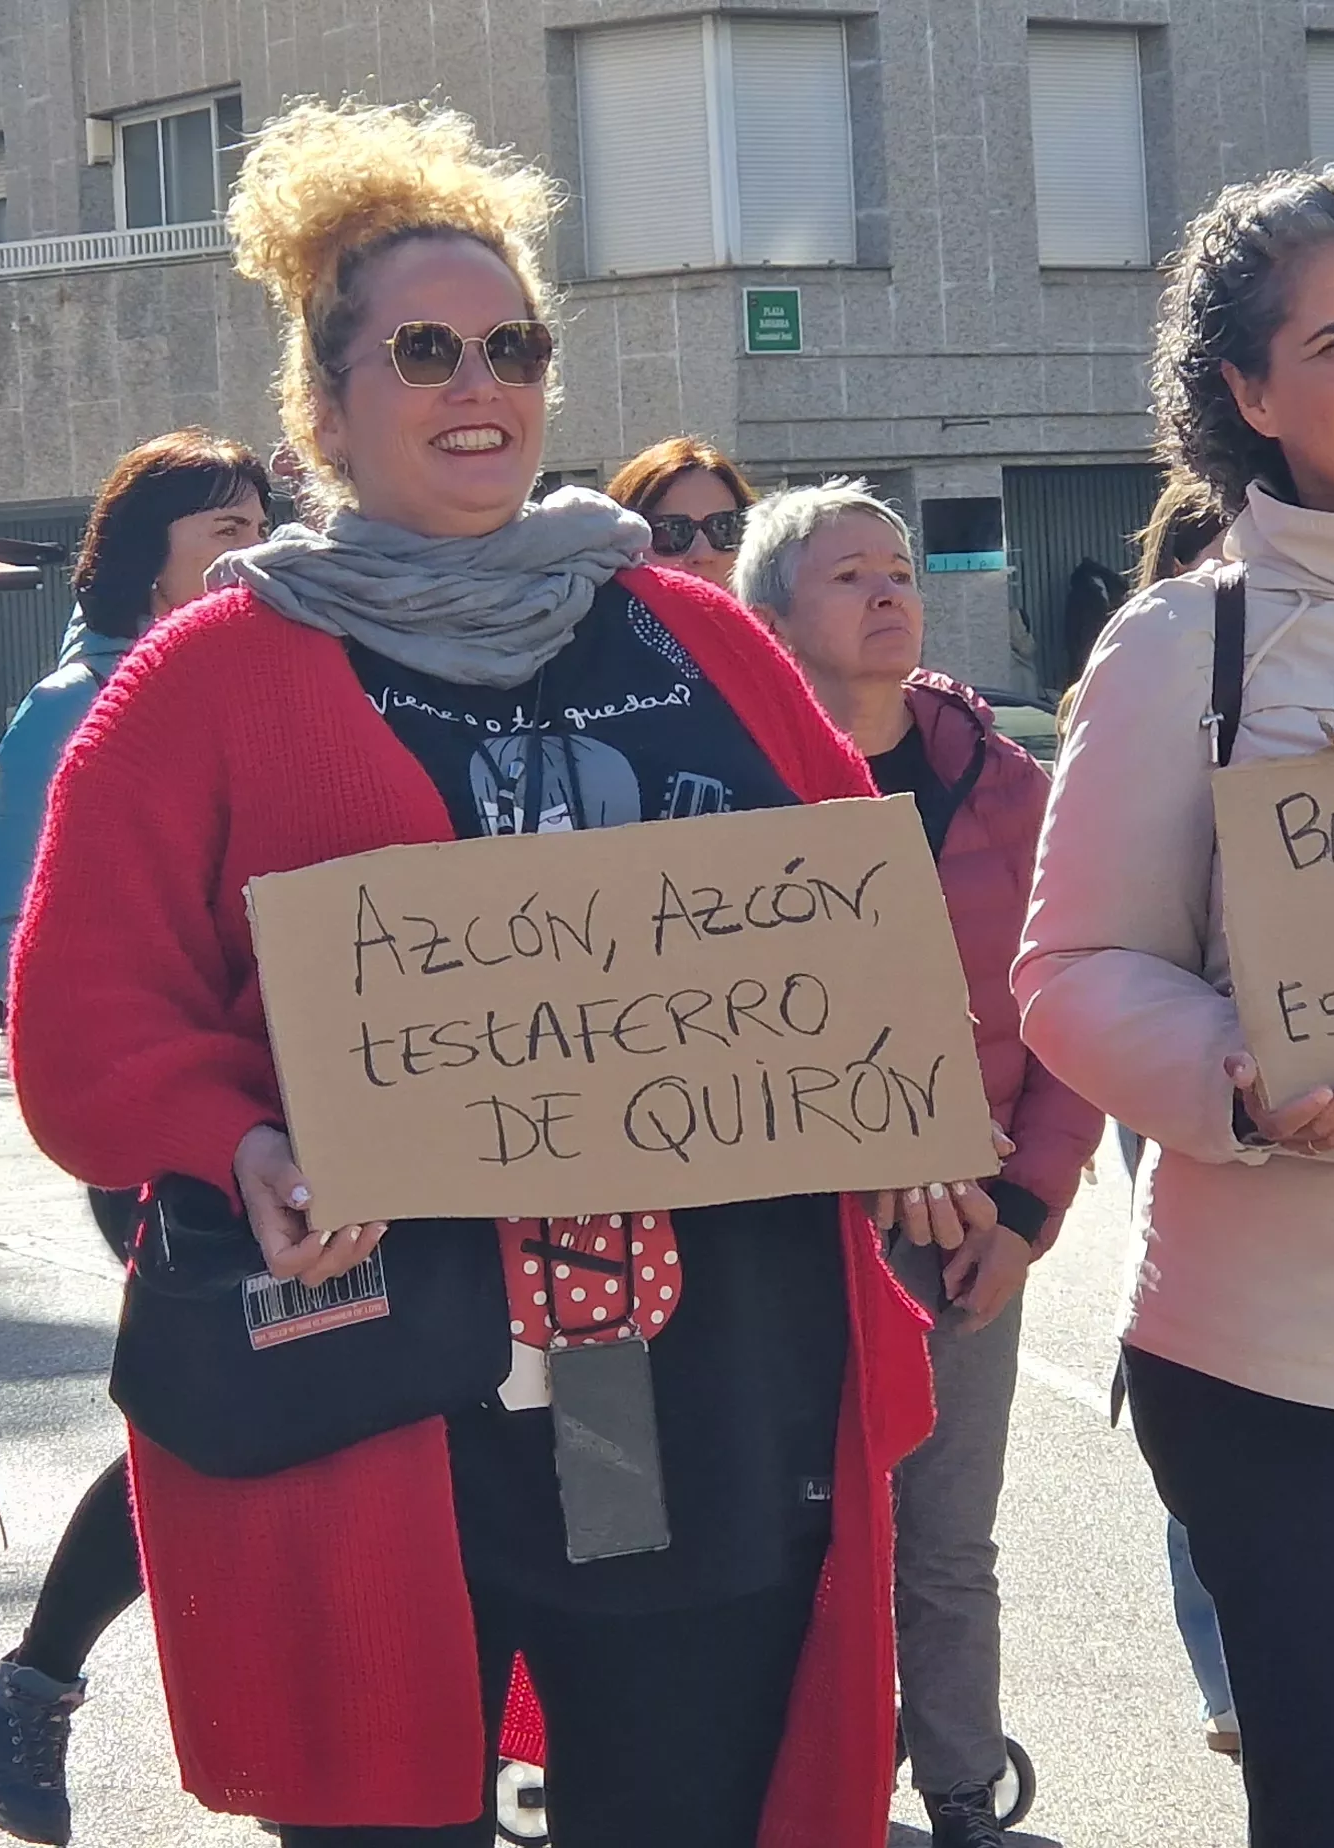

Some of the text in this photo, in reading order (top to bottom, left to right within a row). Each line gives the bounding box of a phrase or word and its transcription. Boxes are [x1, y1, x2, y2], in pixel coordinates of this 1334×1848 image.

[564, 684, 693, 729] quedas?
[354, 857, 888, 995] AZCÓN, AZCÓN,
[465, 1092, 582, 1166] DE
